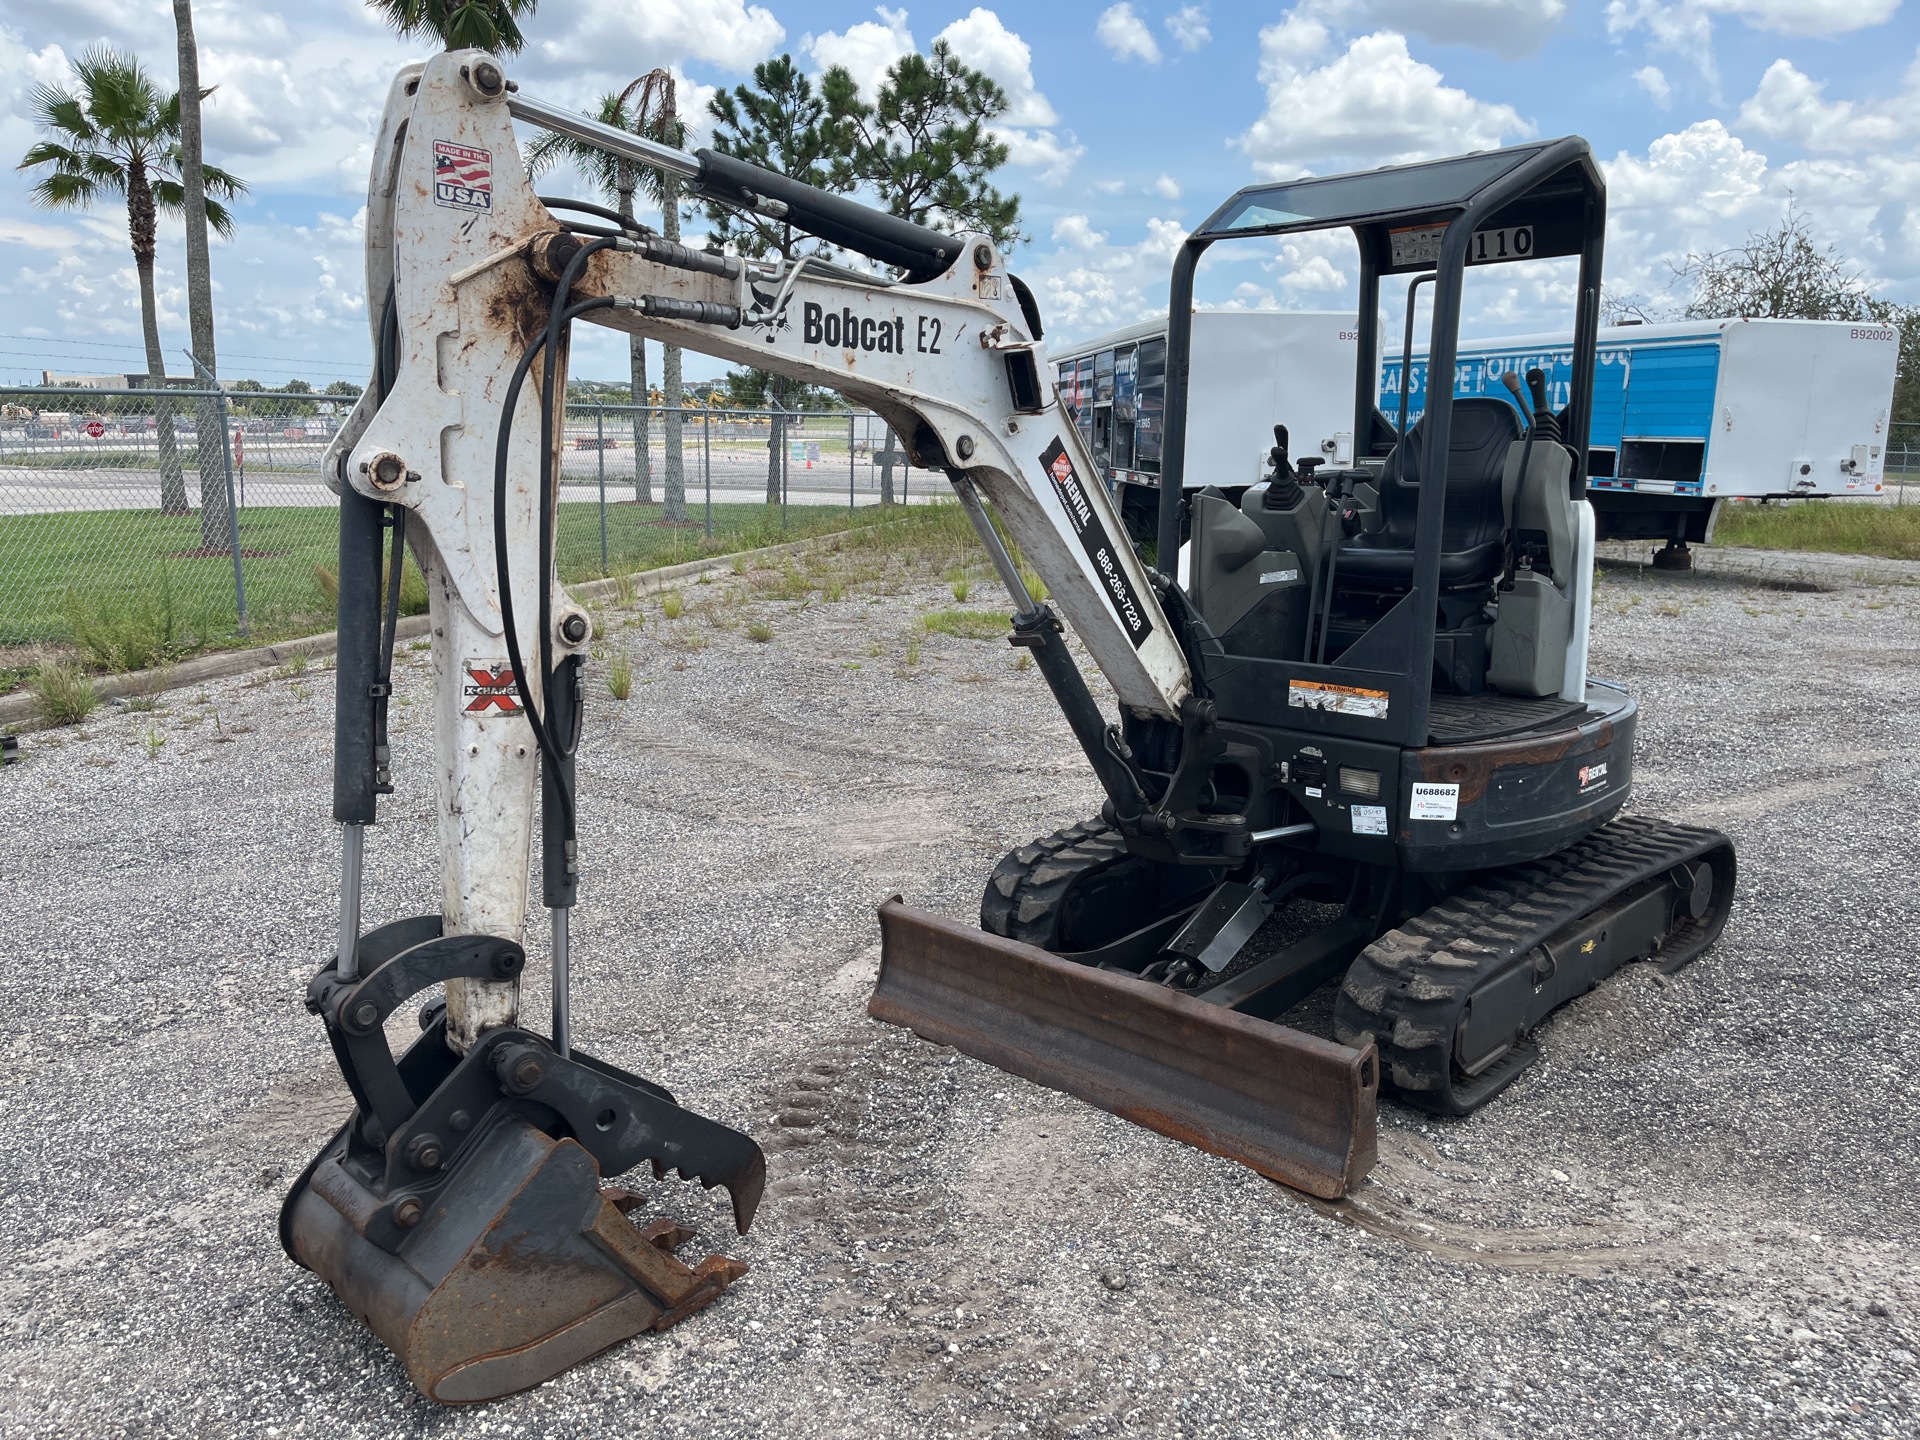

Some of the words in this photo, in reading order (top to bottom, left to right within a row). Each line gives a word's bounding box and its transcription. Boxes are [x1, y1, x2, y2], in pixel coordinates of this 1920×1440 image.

[438, 145, 461, 156] MADE
[472, 153, 487, 161] THE
[438, 184, 488, 207] USA
[1476, 228, 1532, 259] 110
[803, 301, 905, 355] Bobcat
[1339, 332, 1358, 340] B92
[1850, 329, 1893, 341] B92002
[87, 426, 104, 434] STOP
[1049, 472, 1083, 535] homedepot.com/rental
[1063, 473, 1092, 527] RENTAL
[1096, 547, 1142, 632] 888-266-7228
[1327, 685, 1357, 694] WARNING
[1416, 787, 1457, 796] U688682
